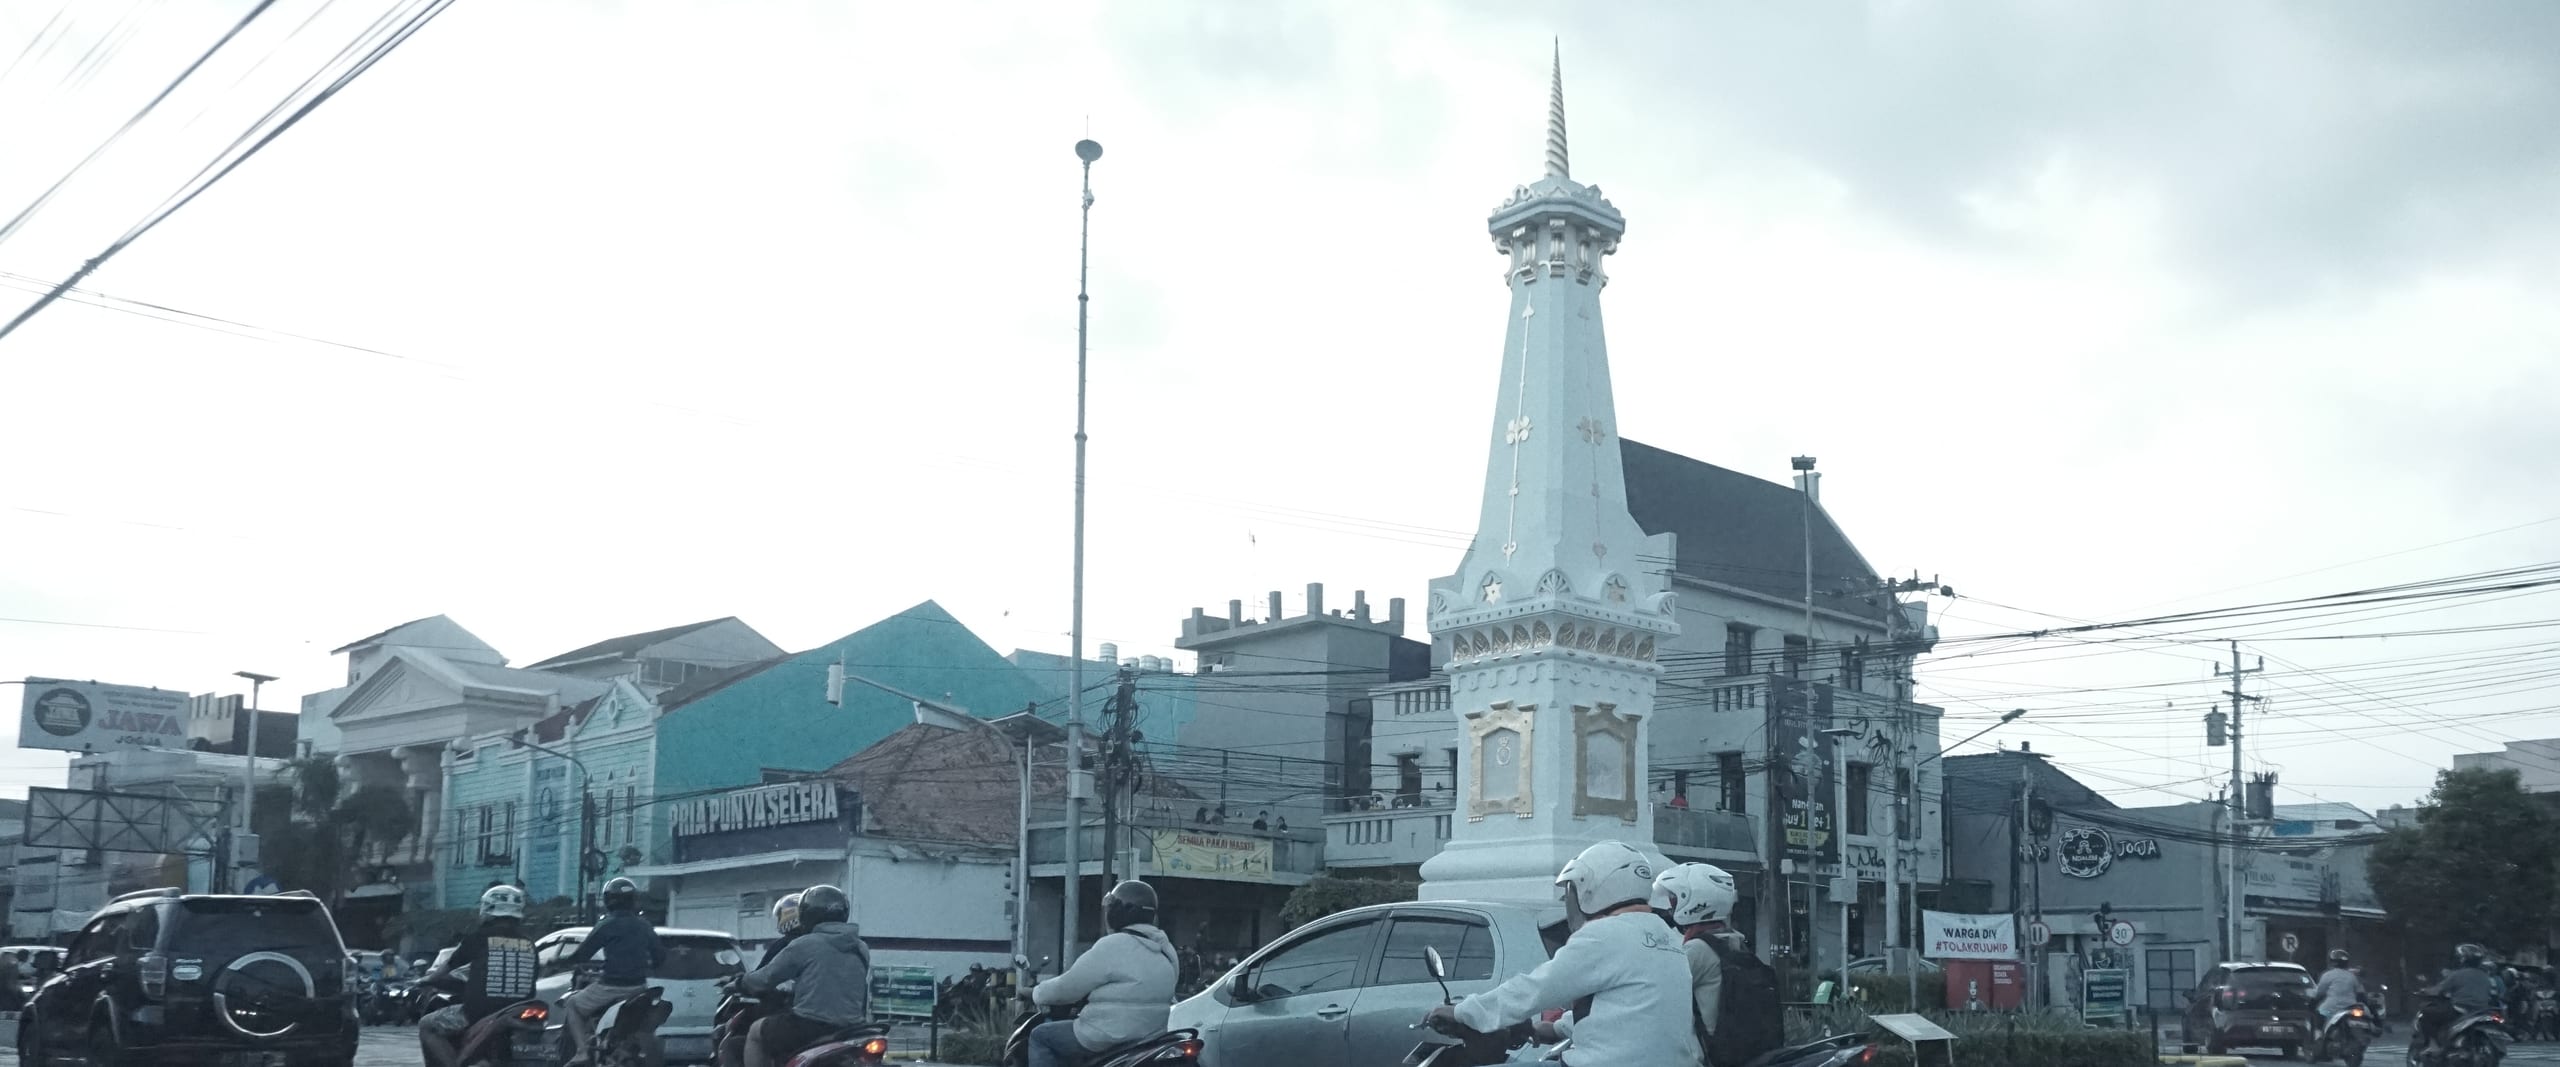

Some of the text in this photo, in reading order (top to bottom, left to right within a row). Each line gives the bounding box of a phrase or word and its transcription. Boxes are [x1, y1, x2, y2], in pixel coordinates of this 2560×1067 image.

[98, 709, 183, 736] JAWA
[668, 799, 707, 837] PRIA
[767, 782, 839, 827] SELERA
[2116, 840, 2158, 856] JOGJA
[1943, 928, 1998, 940] WARGA DIY
[2114, 928, 2128, 939] 30
[1935, 941, 2009, 953] #TOLAKRUUHIP
